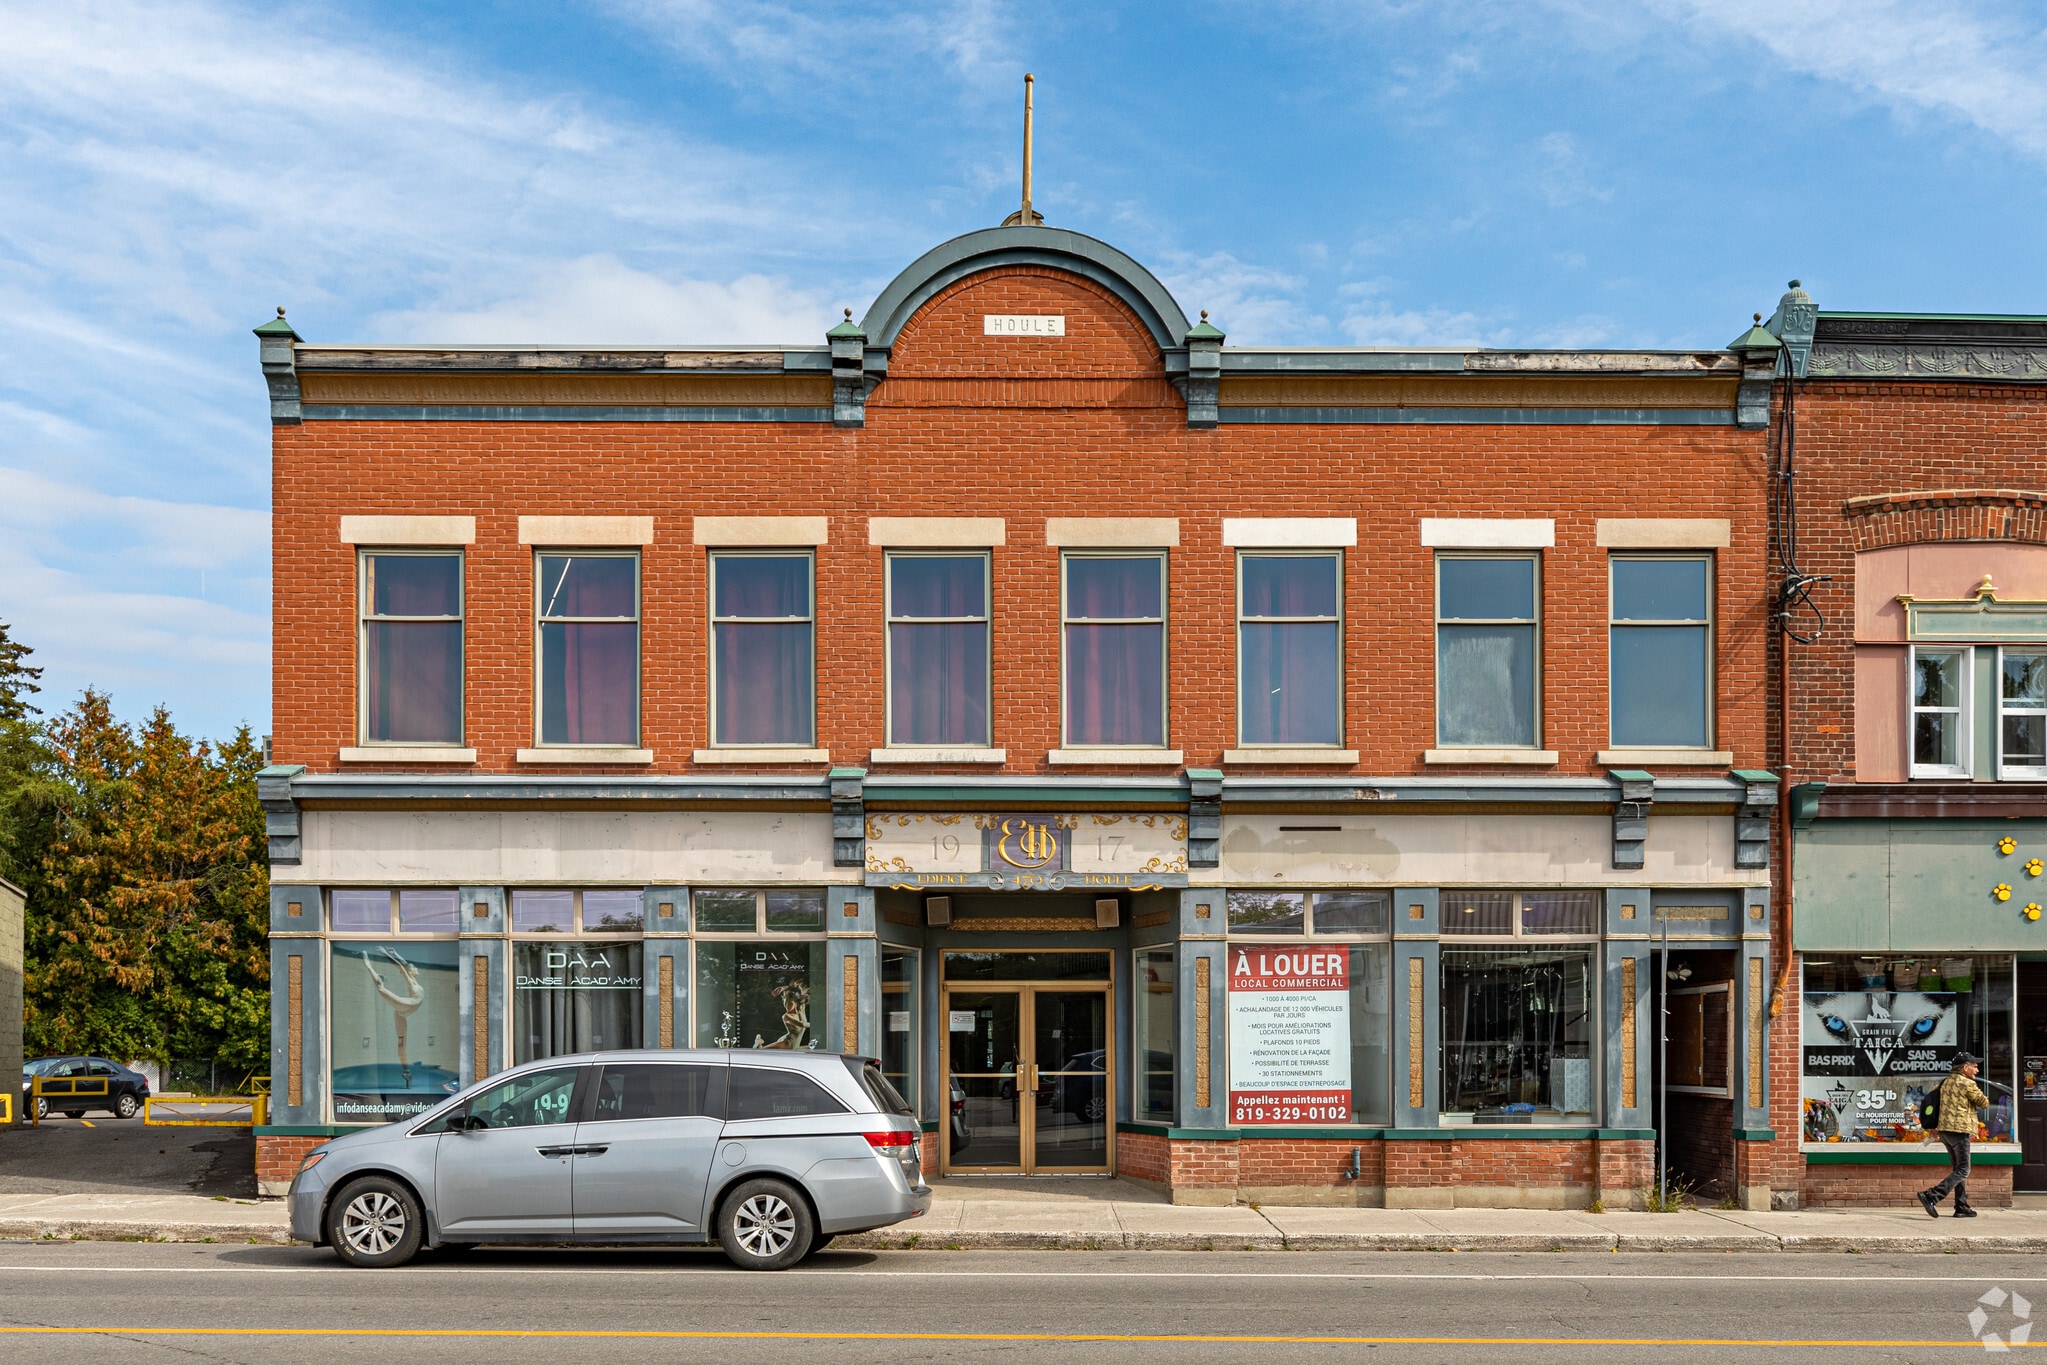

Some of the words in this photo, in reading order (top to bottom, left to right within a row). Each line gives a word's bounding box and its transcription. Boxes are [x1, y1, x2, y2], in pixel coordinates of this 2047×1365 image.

[994, 319, 1055, 332] HOULE
[931, 834, 960, 861] 19
[1096, 836, 1126, 862] 17
[1086, 874, 1133, 885] HOULE
[547, 953, 611, 968] DAA
[1235, 950, 1251, 976] À
[1260, 954, 1342, 975] LOUER
[516, 976, 562, 985] DANSE
[1273, 979, 1343, 987] COMMERCIAL
[1853, 1038, 1905, 1048] TAIGA
[1908, 1050, 1936, 1060] SANS
[1808, 1056, 1830, 1066] BAS
[1831, 1056, 1855, 1066] PRIX
[1890, 1061, 1952, 1071] COMPROMIS
[1237, 1095, 1279, 1106] Appellez
[1283, 1095, 1338, 1104] maintenant
[1236, 1107, 1347, 1120] 819-329-0102
